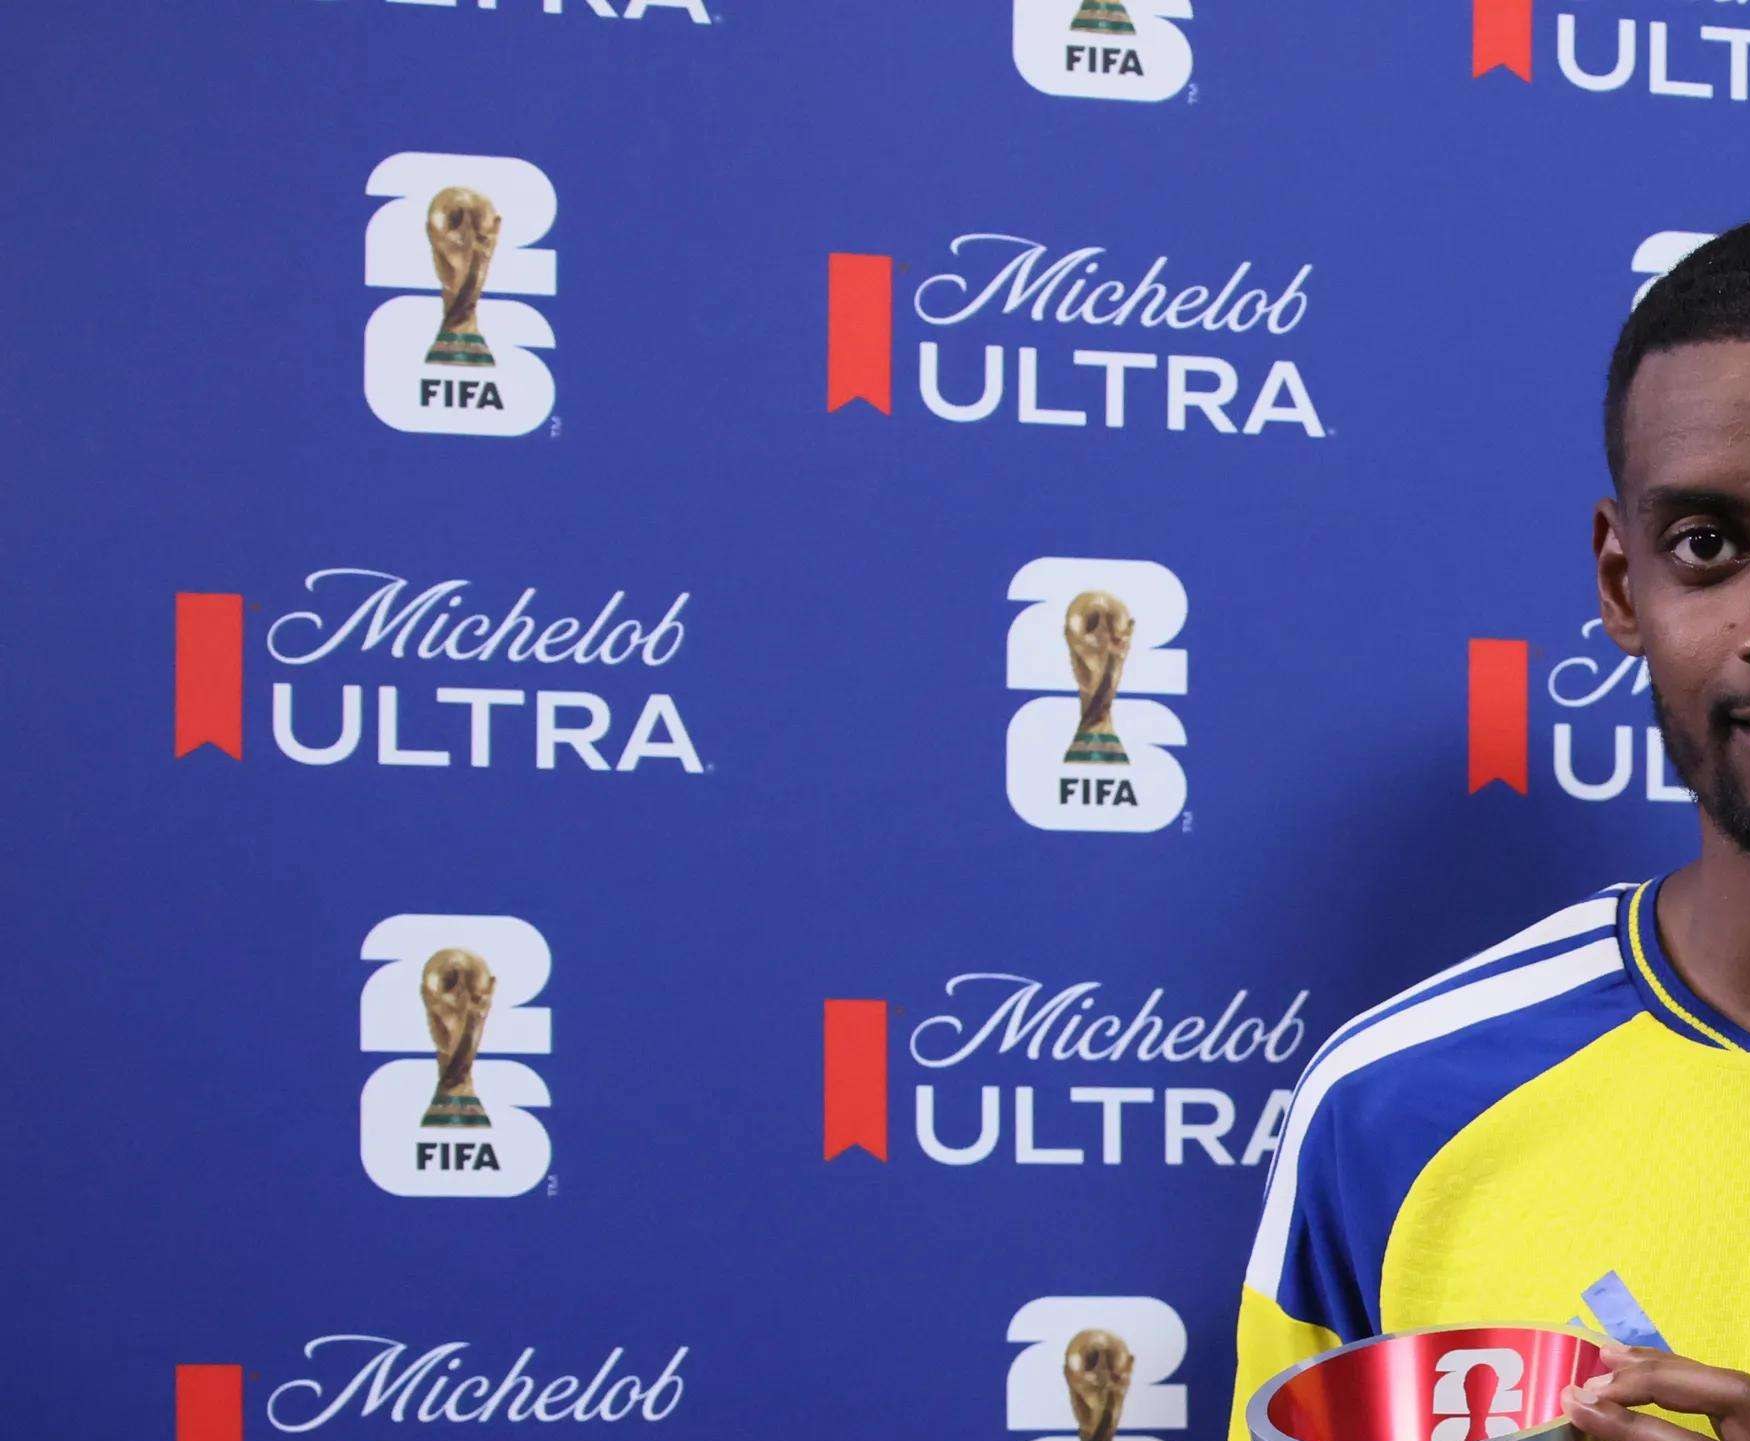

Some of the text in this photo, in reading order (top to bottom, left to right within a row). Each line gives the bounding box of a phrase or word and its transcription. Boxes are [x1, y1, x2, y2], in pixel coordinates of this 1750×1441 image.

[1067, 46, 1143, 75] FIFA
[914, 233, 1312, 334] Michelob
[421, 379, 503, 409] FIFA
[920, 342, 1325, 437] ULTRA
[267, 568, 690, 666] Michelob
[273, 683, 704, 773] ULTRA
[1060, 778, 1137, 805] FIFA
[910, 973, 1308, 1067] Michelob
[417, 1143, 499, 1170] FIFA
[267, 1335, 688, 1432] Michelob
